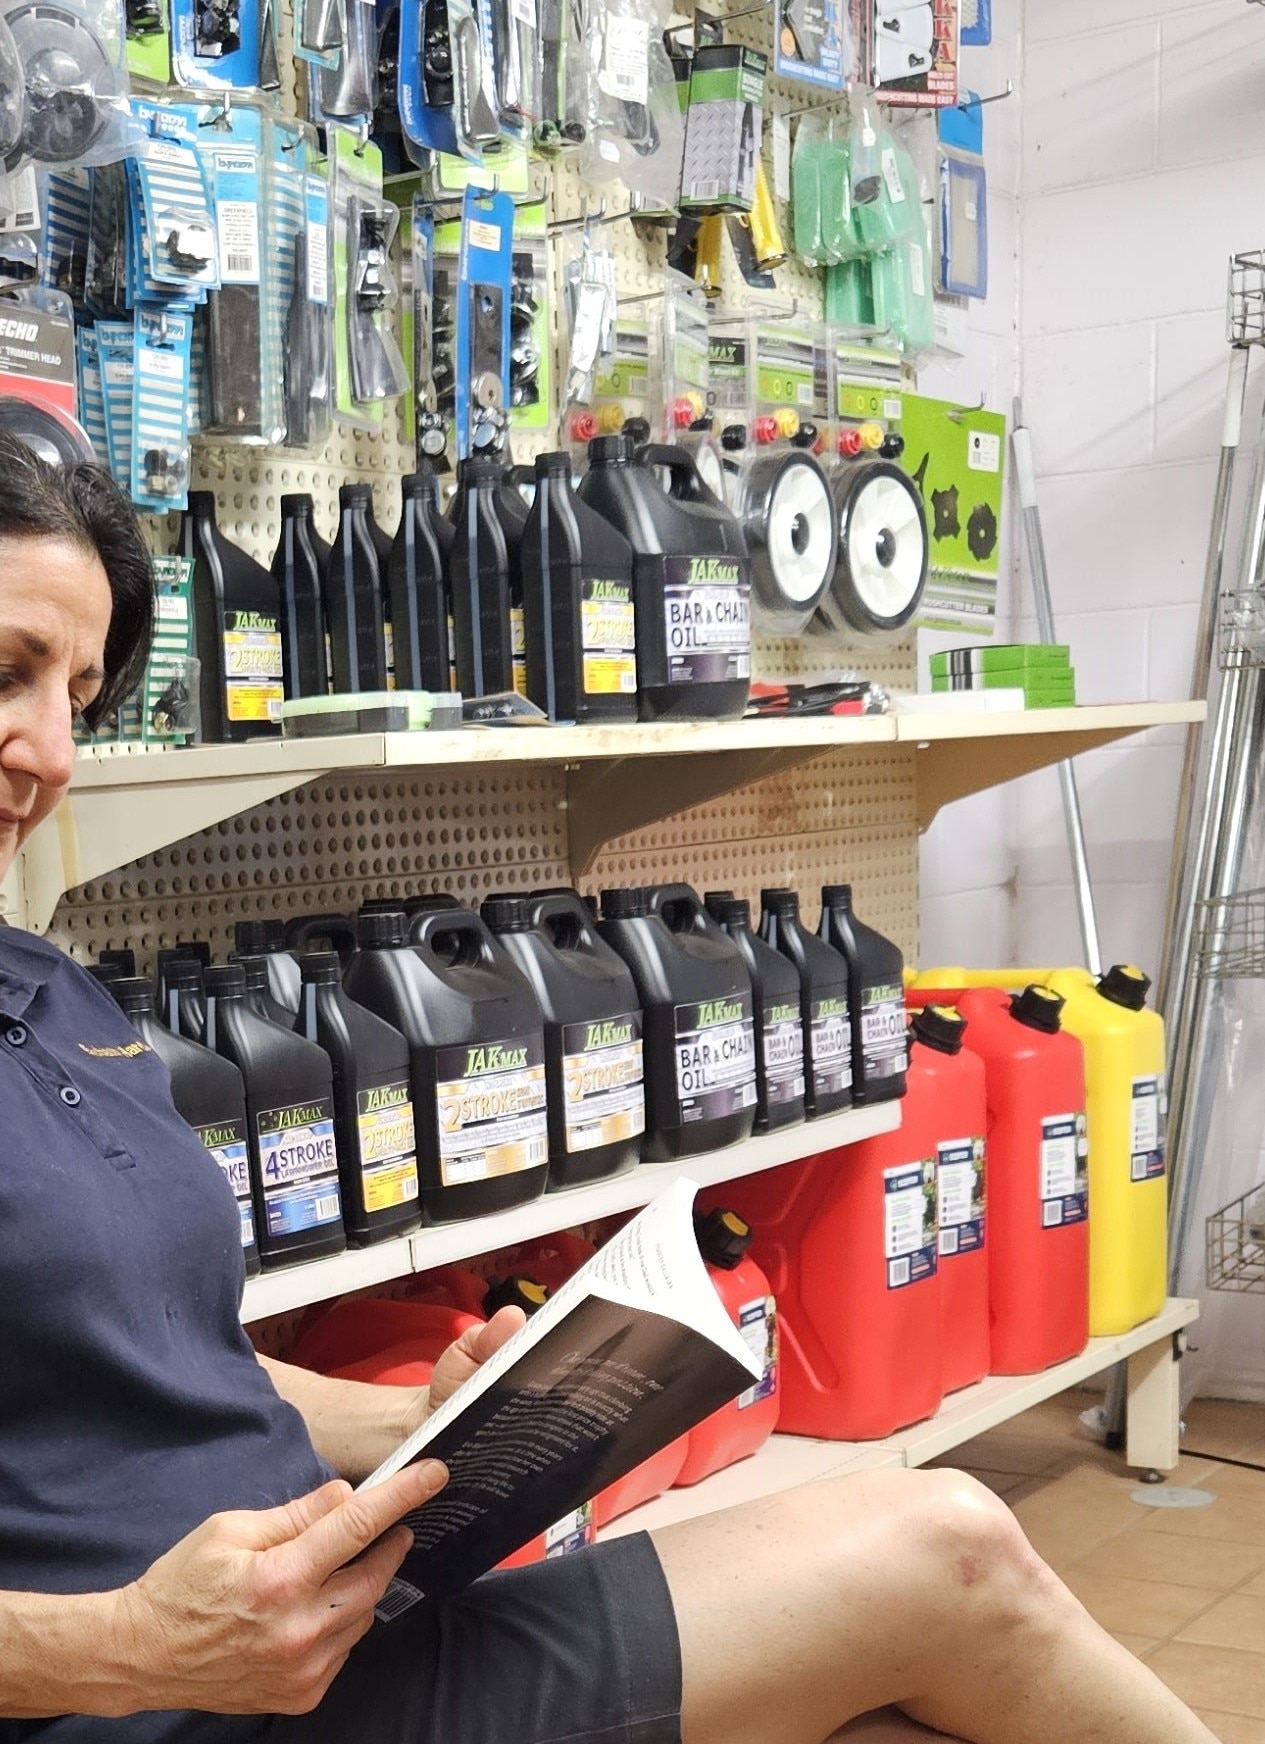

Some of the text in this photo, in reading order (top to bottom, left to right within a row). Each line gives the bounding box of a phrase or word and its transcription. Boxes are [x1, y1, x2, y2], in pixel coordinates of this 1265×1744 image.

[5, 345, 40, 362] TRIMMER
[40, 352, 62, 366] HEAD
[688, 558, 739, 585] JAKMAX
[589, 578, 631, 603] JAKMAX
[233, 611, 276, 632] JAKMAX
[670, 602, 704, 624] BAR
[671, 627, 701, 648] OIL
[696, 1000, 743, 1029] JAKMAX
[584, 1022, 632, 1051] JAKMAX
[464, 1045, 528, 1077] JAKMAX
[680, 1049, 712, 1069] BAR
[682, 1070, 711, 1091] OIL
[365, 1087, 408, 1112] JAKMAX
[278, 1106, 324, 1129] JAKMAX
[198, 1127, 236, 1148] KMAX
